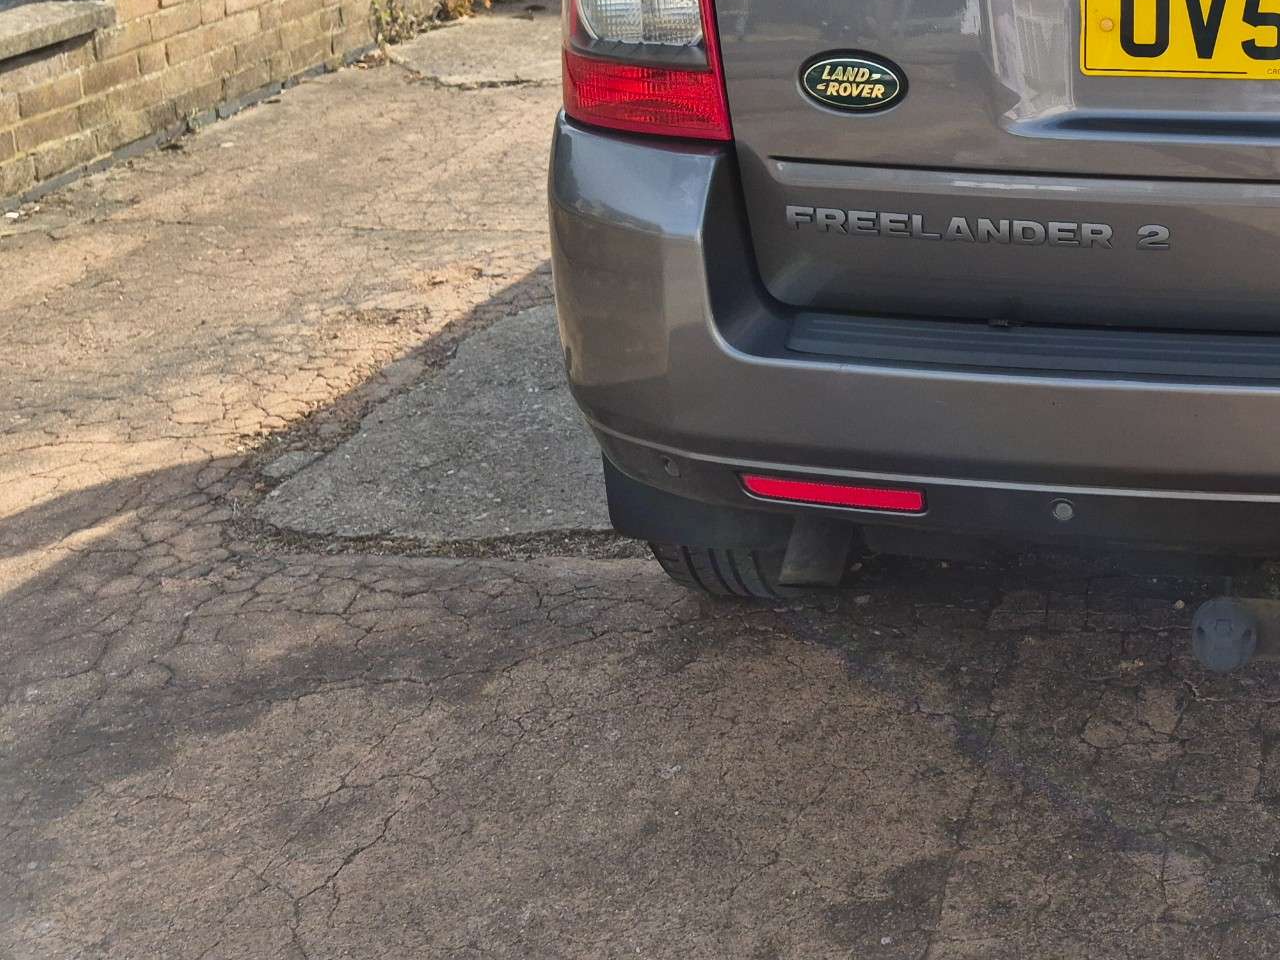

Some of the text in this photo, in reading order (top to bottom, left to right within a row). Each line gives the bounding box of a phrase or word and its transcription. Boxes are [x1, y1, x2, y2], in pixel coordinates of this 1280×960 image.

[821, 65, 870, 82] LAND
[826, 81, 885, 98] ROVER
[786, 204, 1171, 250] FREELANDER 2
